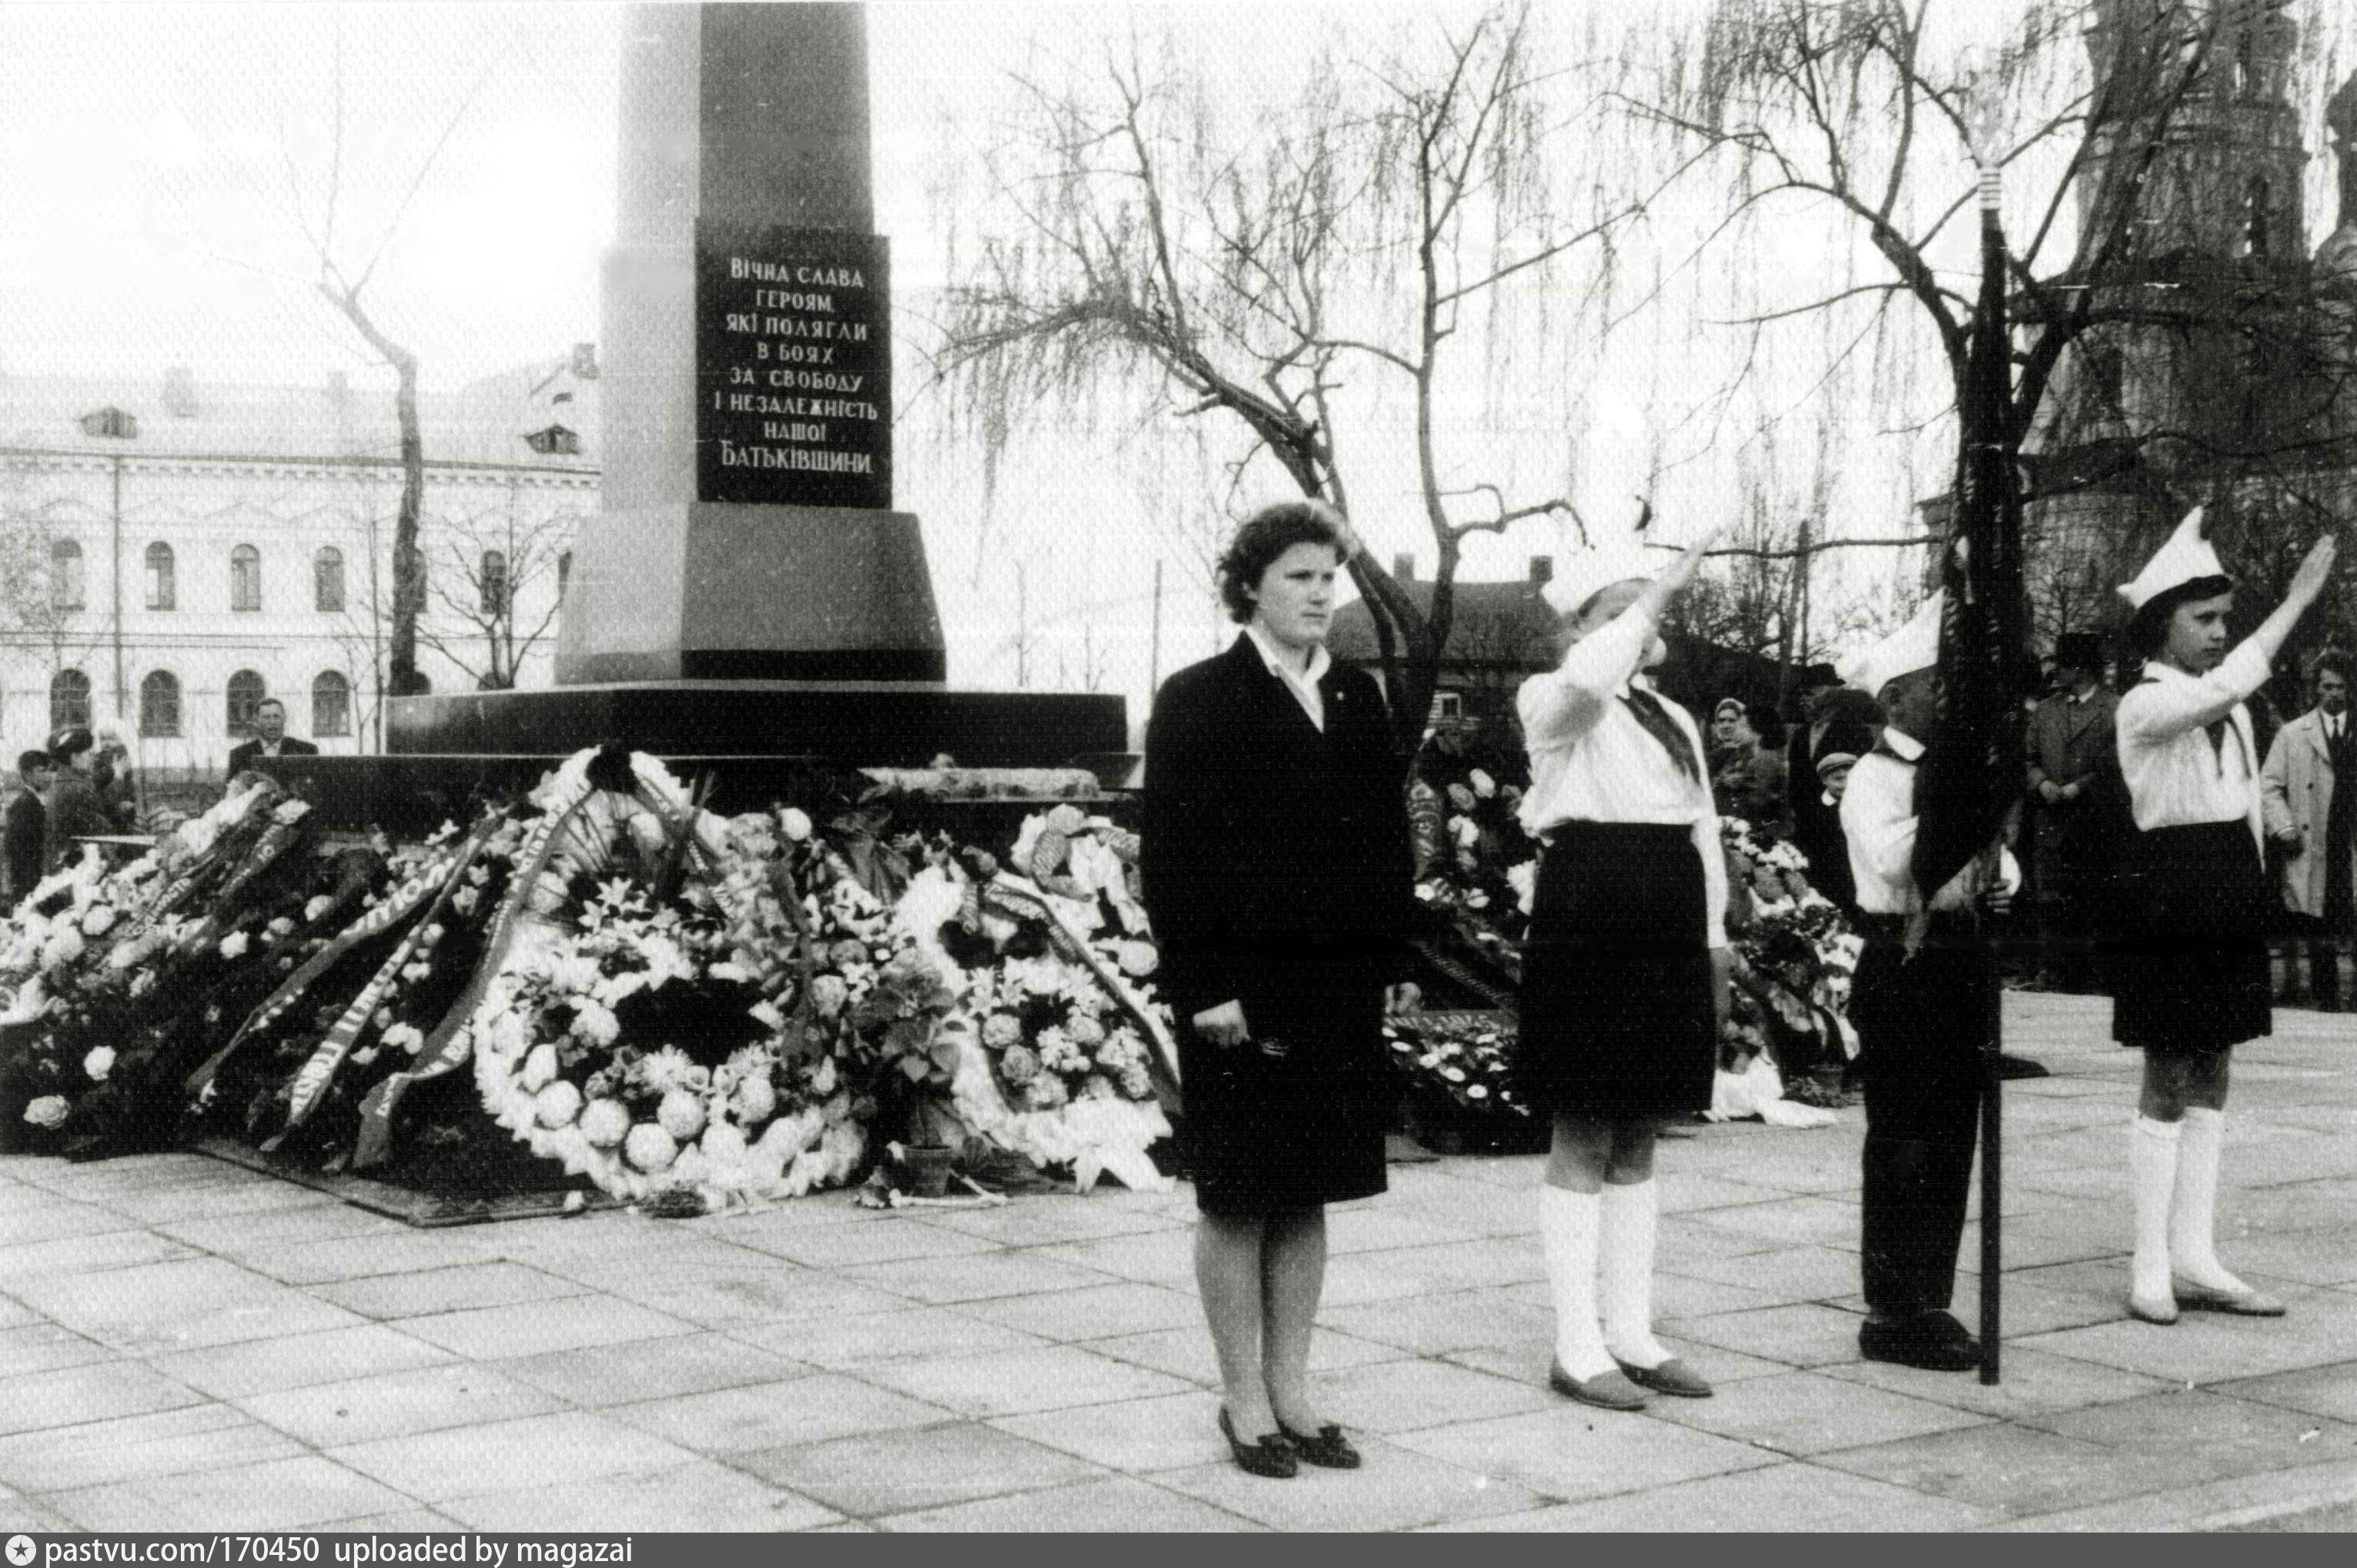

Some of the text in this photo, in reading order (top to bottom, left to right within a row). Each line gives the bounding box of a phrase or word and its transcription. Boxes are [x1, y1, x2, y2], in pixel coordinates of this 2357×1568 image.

[731, 257, 864, 288] ВІЧНА СЛАВА
[727, 313, 868, 341] ЯКІ ПОЛЯГЛИ
[757, 341, 834, 365] В БОЯХ
[731, 366, 863, 392] ЗА СВОБОДУ
[714, 390, 878, 420] І НЕЗАЛЕЖНІСТЬ
